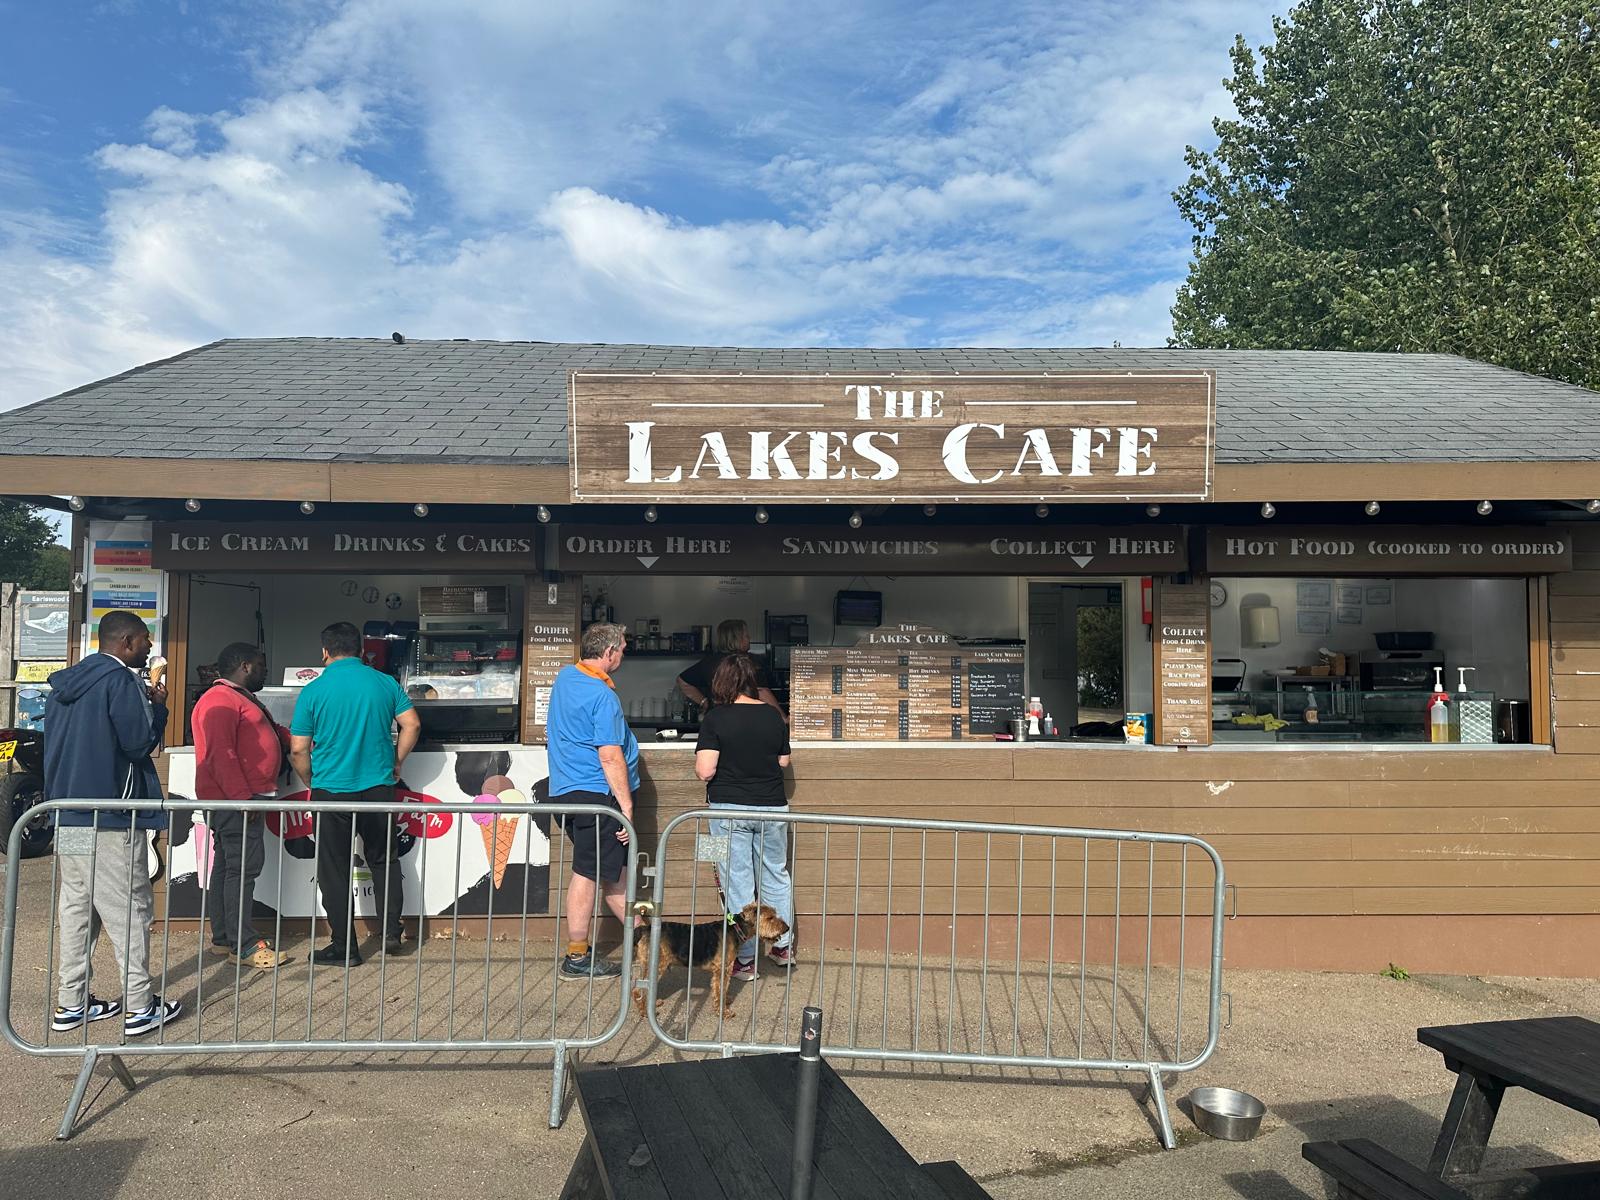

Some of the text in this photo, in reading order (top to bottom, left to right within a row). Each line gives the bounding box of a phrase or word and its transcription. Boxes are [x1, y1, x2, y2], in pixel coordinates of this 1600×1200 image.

[845, 384, 943, 420] THE
[625, 421, 1157, 485] LAKES CAFE
[170, 533, 309, 551] ICE CREAM
[334, 534, 425, 552] DRINKS
[457, 534, 530, 552] CAKES
[566, 536, 731, 554] ORDER HERE
[782, 537, 938, 556] SANDWICHES
[990, 538, 1176, 555] COLLECT HERE
[1226, 538, 1278, 555] HOT
[1290, 538, 1355, 556] FOOD
[534, 625, 568, 634] ORDER
[898, 624, 918, 632] THE
[1162, 626, 1205, 636] COLLECT
[870, 634, 948, 644] LAKES CAFE
